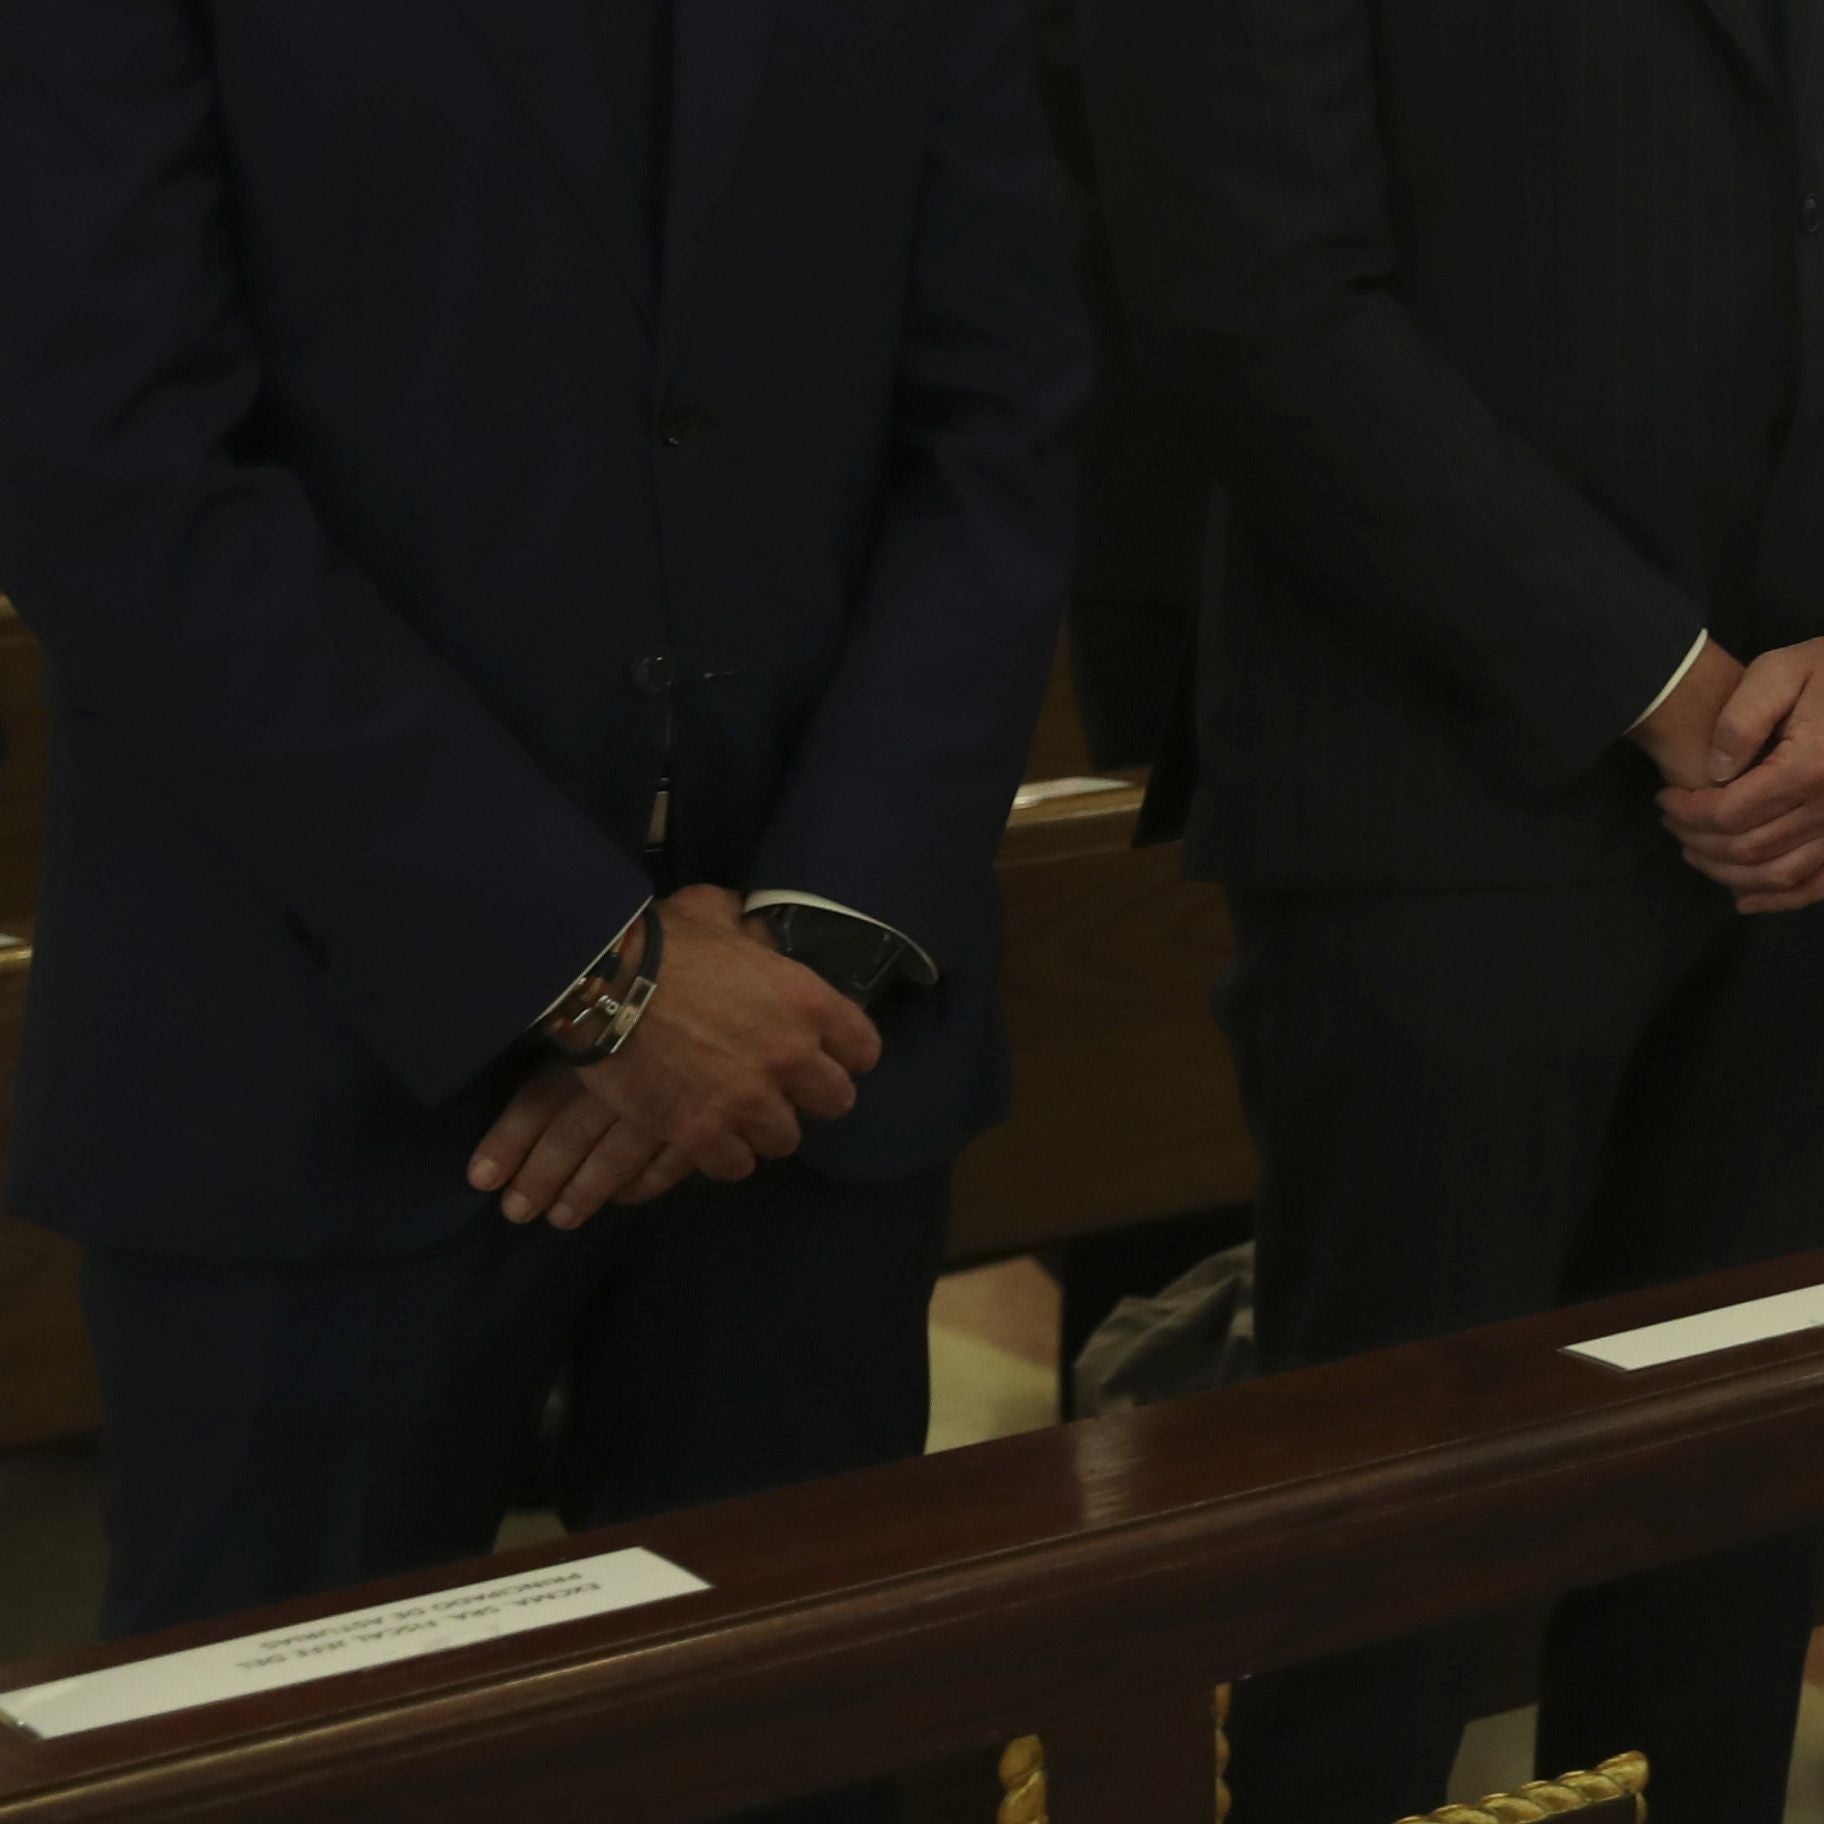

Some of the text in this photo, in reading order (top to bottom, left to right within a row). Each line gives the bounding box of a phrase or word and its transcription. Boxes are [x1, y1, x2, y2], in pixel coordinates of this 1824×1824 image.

[259, 1572, 583, 1649] PRINCIPADO DE ASTURIAS
[352, 1619, 438, 1642] FISCAL
[294, 1639, 347, 1658] JEFE
[236, 1654, 288, 1669] DEL
